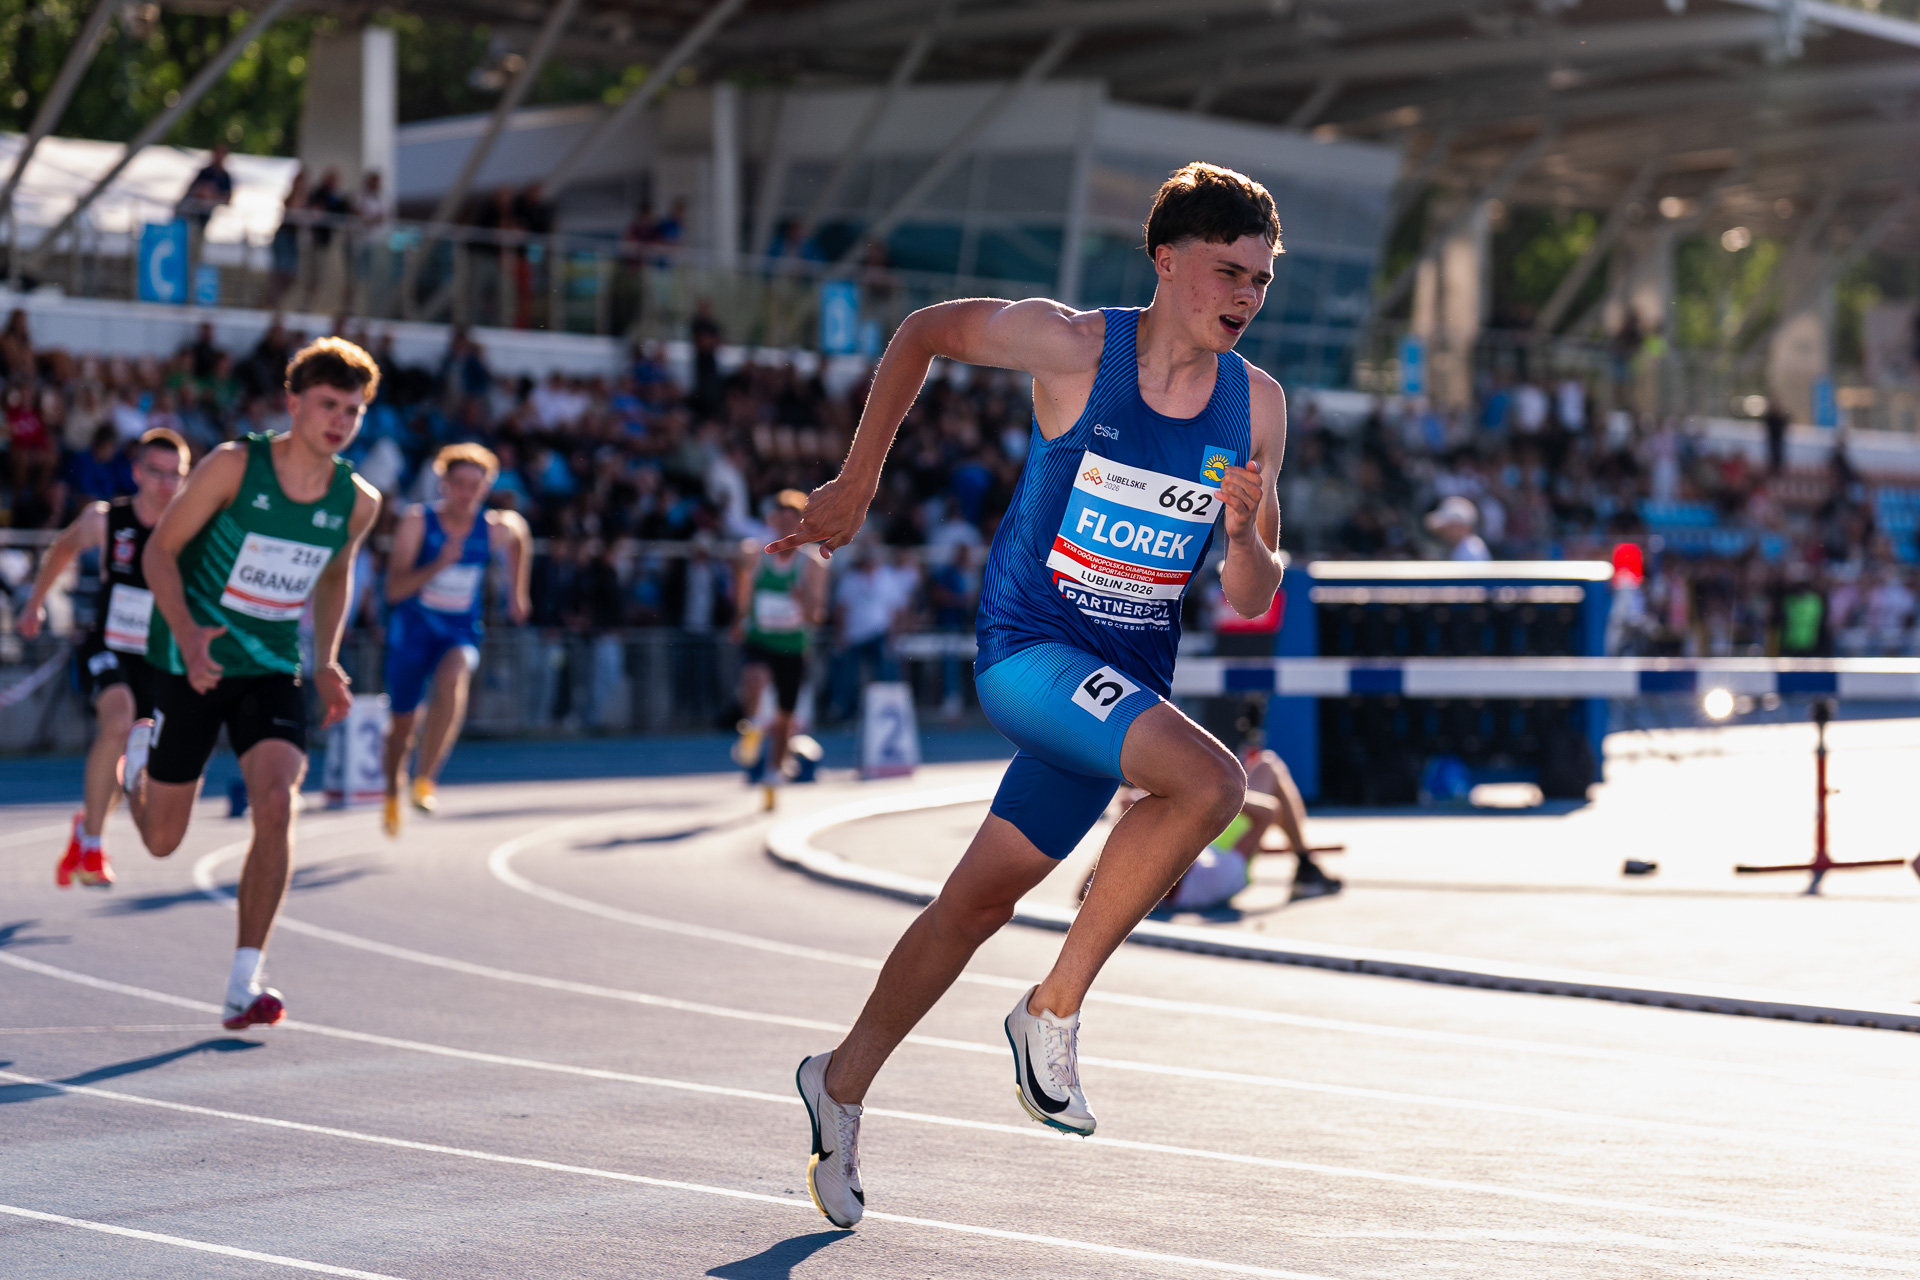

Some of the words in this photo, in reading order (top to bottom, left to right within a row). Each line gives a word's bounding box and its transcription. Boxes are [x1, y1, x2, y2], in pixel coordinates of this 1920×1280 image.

[149, 240, 175, 300] C
[1104, 481, 1120, 492] 2026
[1106, 473, 1147, 490] LUBELSKIE
[1158, 485, 1213, 516] 662
[1076, 507, 1194, 559] FLOREK
[1077, 549, 1125, 570] OGÓLNOPOLSKA
[1125, 565, 1156, 577] OLIMPIADA
[1098, 565, 1130, 577] SPORTACH
[1130, 572, 1154, 582] LETNICH
[1081, 570, 1123, 589] LUBLIN
[1124, 582, 1154, 595] 2026
[1090, 618, 1146, 630] OWOCESNE
[1083, 672, 1124, 706] 5
[879, 706, 907, 760] 2
[360, 721, 382, 781] 3
